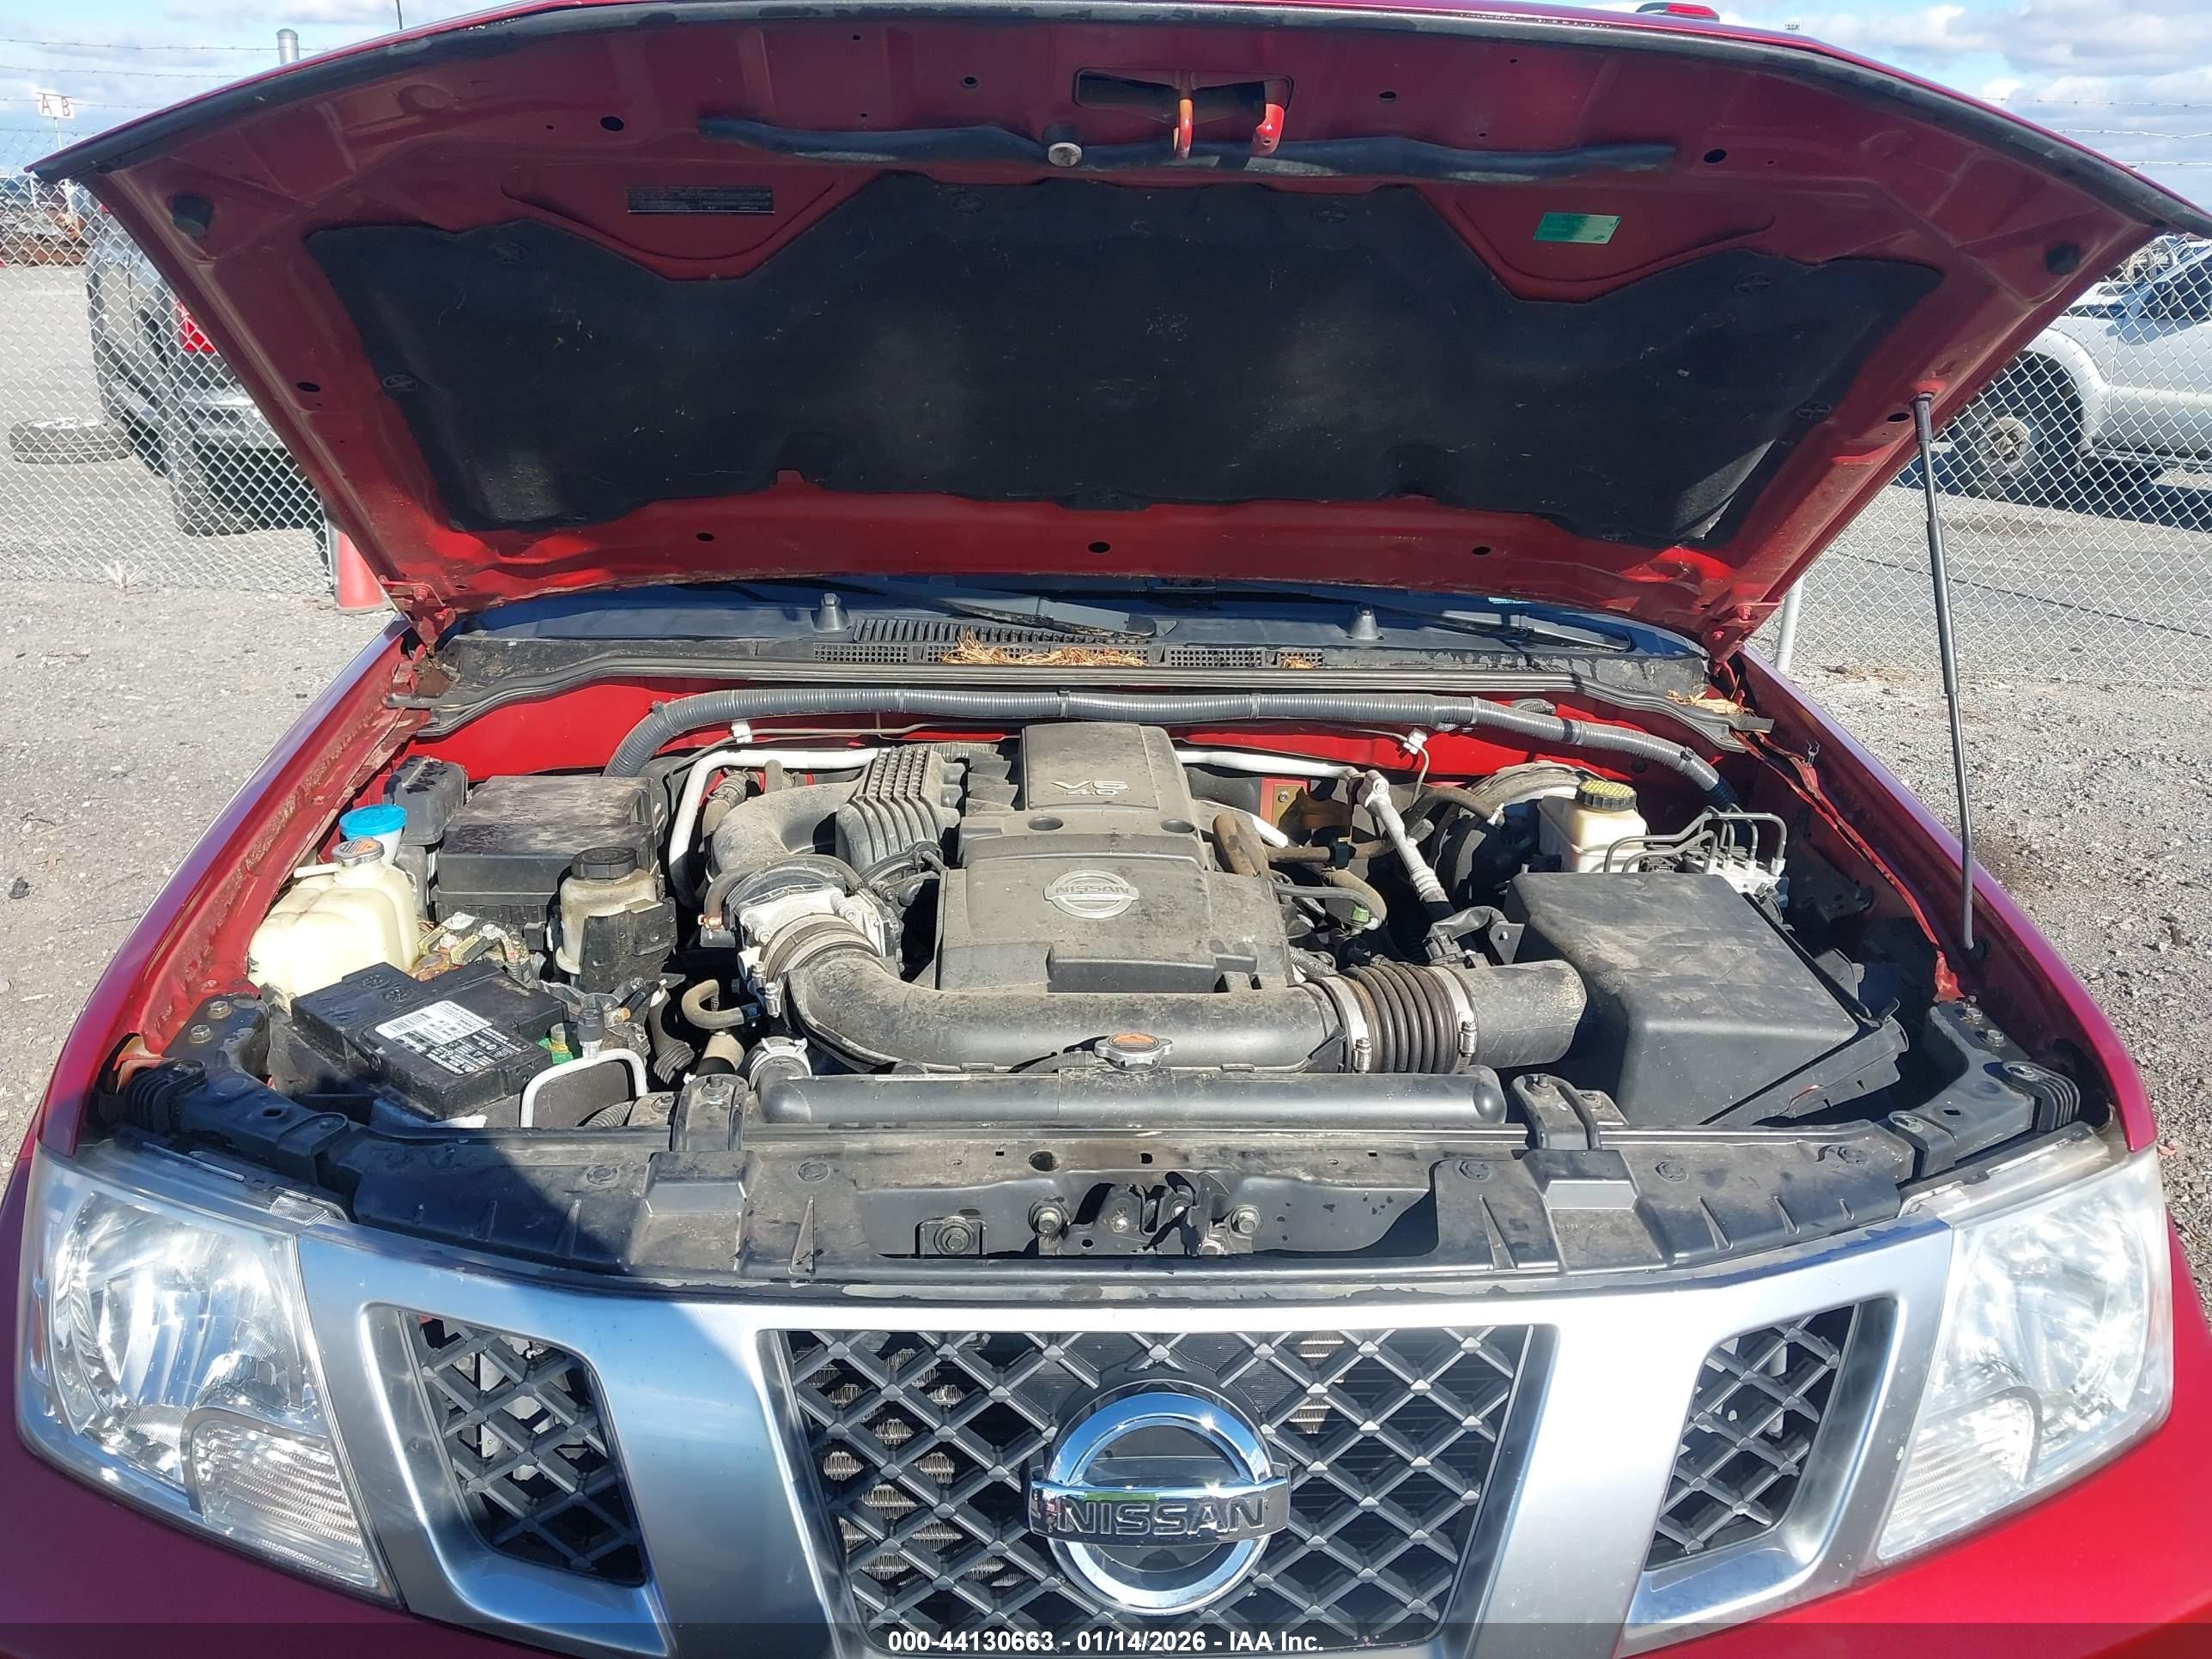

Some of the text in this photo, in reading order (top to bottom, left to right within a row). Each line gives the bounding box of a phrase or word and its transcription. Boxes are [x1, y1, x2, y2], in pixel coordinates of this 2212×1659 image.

[41, 94, 70, 117] A B
[1050, 780, 1128, 790] V6
[1055, 884, 1129, 894] NISSAN
[1056, 1496, 1266, 1536] NISSAN
